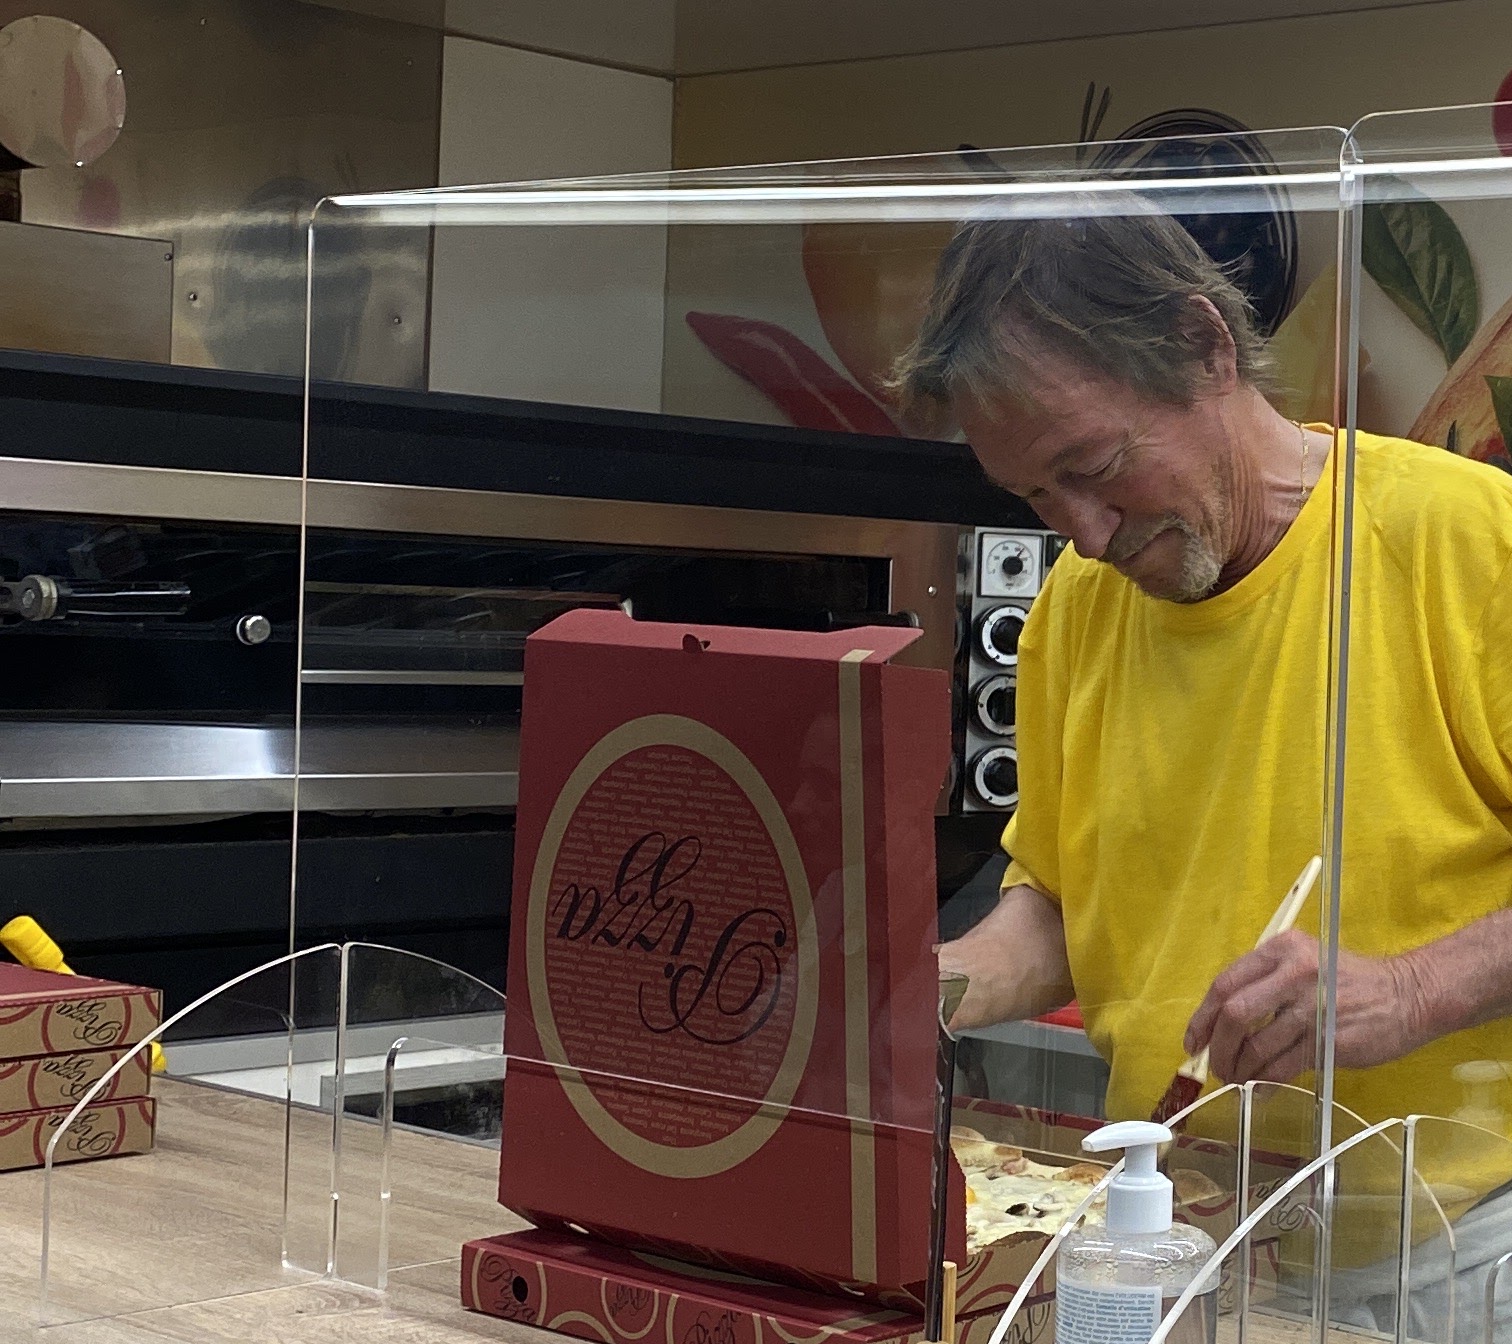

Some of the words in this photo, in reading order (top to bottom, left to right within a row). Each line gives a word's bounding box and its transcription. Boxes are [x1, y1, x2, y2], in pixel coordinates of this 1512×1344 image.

[552, 831, 787, 1046] Pizza
[56, 1000, 123, 1046] Pizza
[43, 1054, 112, 1102] Pizza
